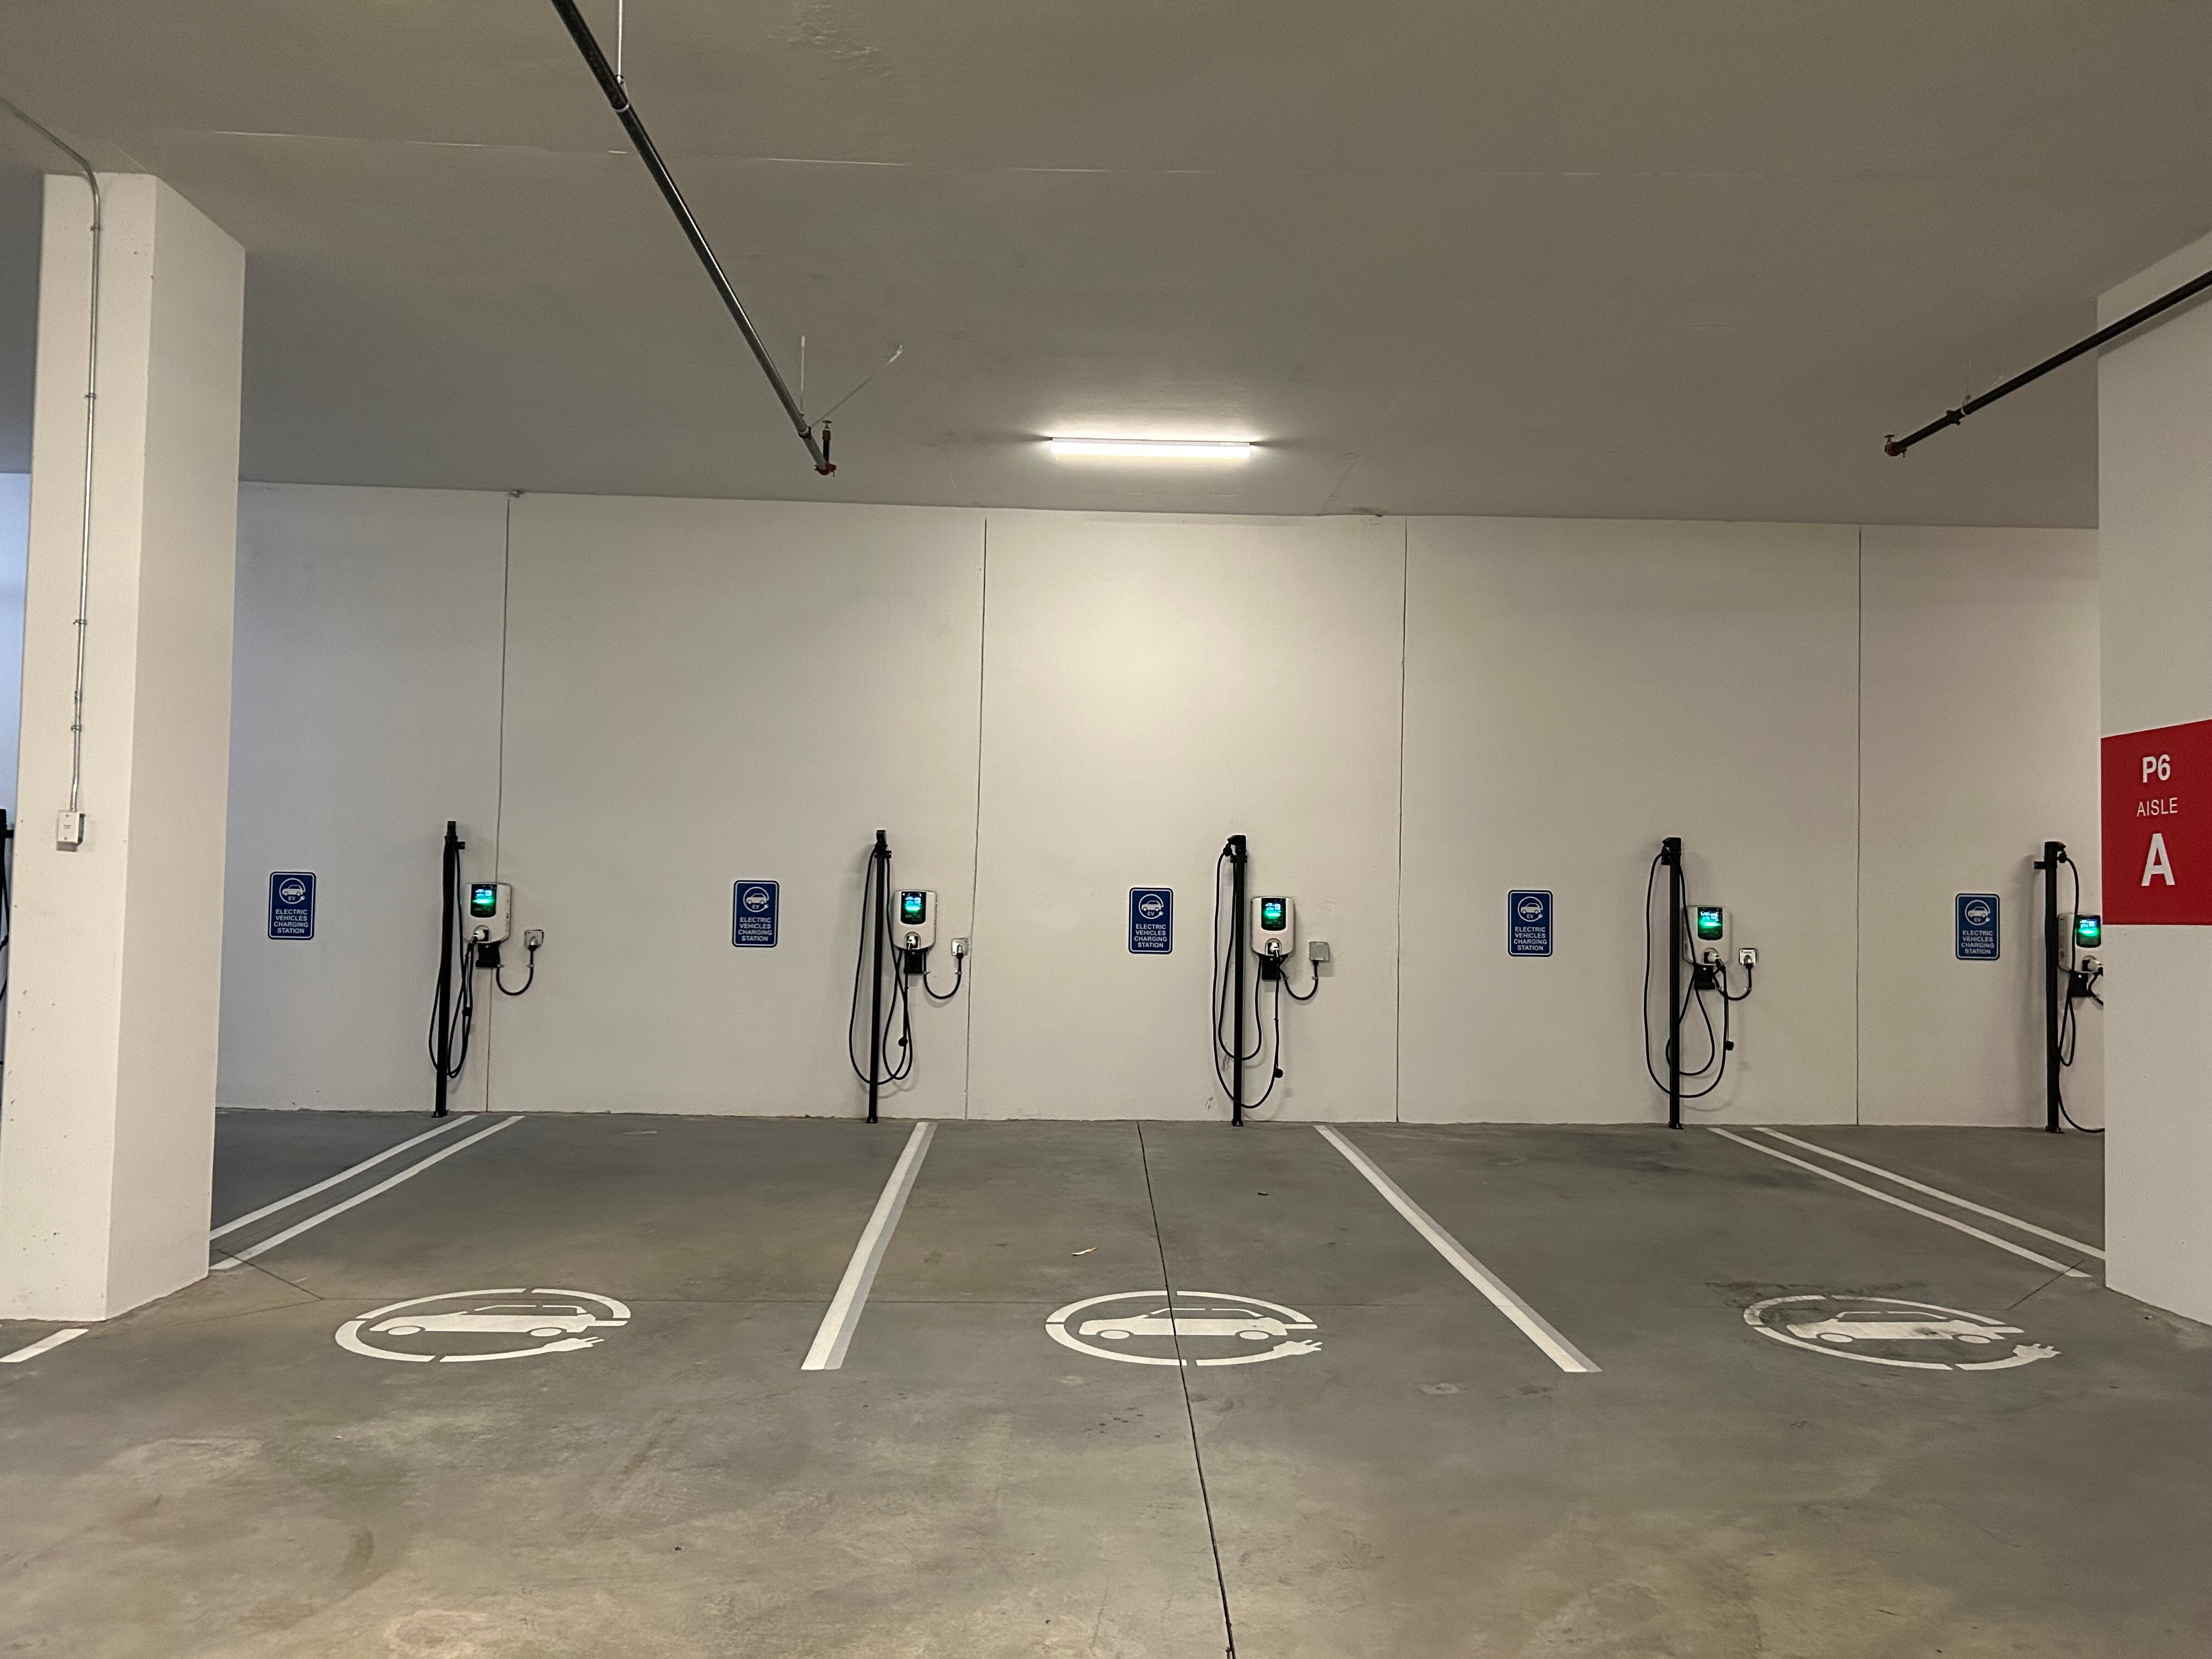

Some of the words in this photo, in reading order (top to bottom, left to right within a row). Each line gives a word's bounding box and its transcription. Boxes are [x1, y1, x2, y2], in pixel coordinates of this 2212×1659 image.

[2142, 754, 2171, 783] P6
[2136, 797, 2179, 817] AISLE
[2141, 833, 2175, 887] A
